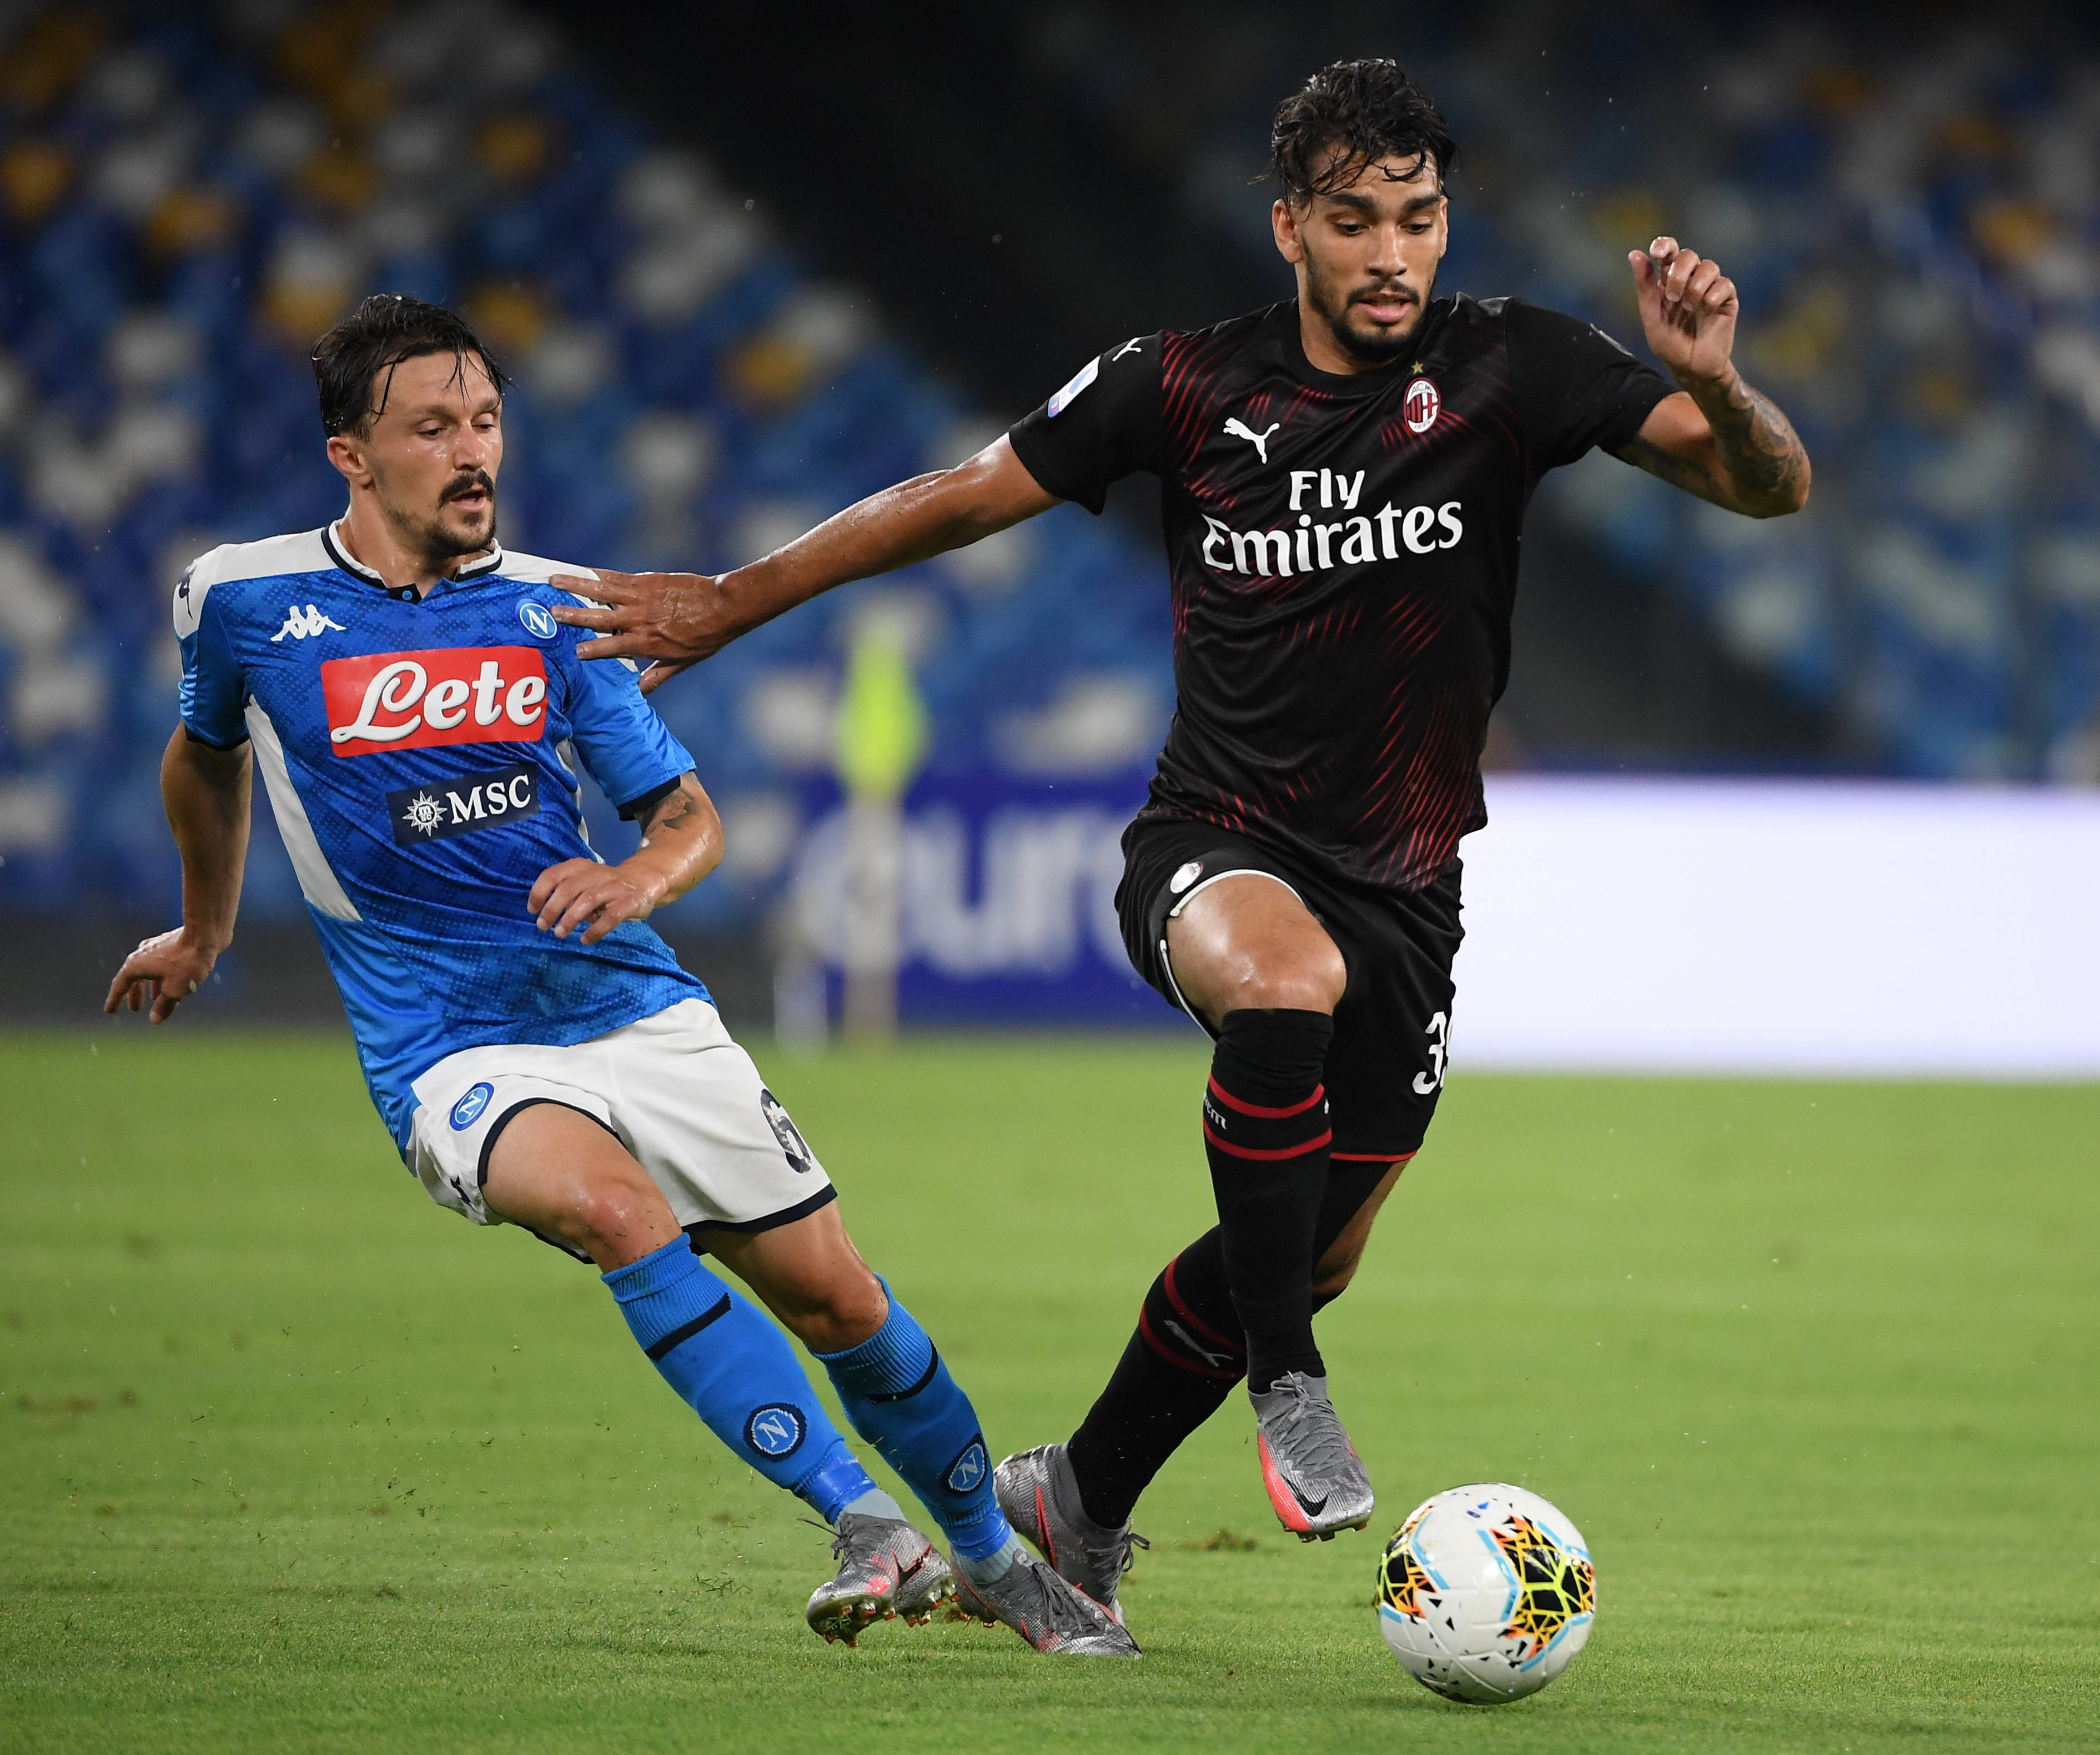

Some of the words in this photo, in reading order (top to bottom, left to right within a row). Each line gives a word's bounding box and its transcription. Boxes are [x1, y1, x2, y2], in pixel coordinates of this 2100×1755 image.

[1411, 383, 1432, 395] ACM
[1289, 468, 1365, 510] Fly
[1203, 502, 1463, 576] Emirates
[526, 609, 548, 634] N
[331, 660, 546, 743] Lete
[446, 775, 531, 824] MSC
[1412, 1011, 1453, 1094] 3
[458, 1092, 482, 1118] N
[760, 1089, 811, 1174] 6
[757, 1415, 788, 1448] N
[958, 1451, 979, 1485] N
